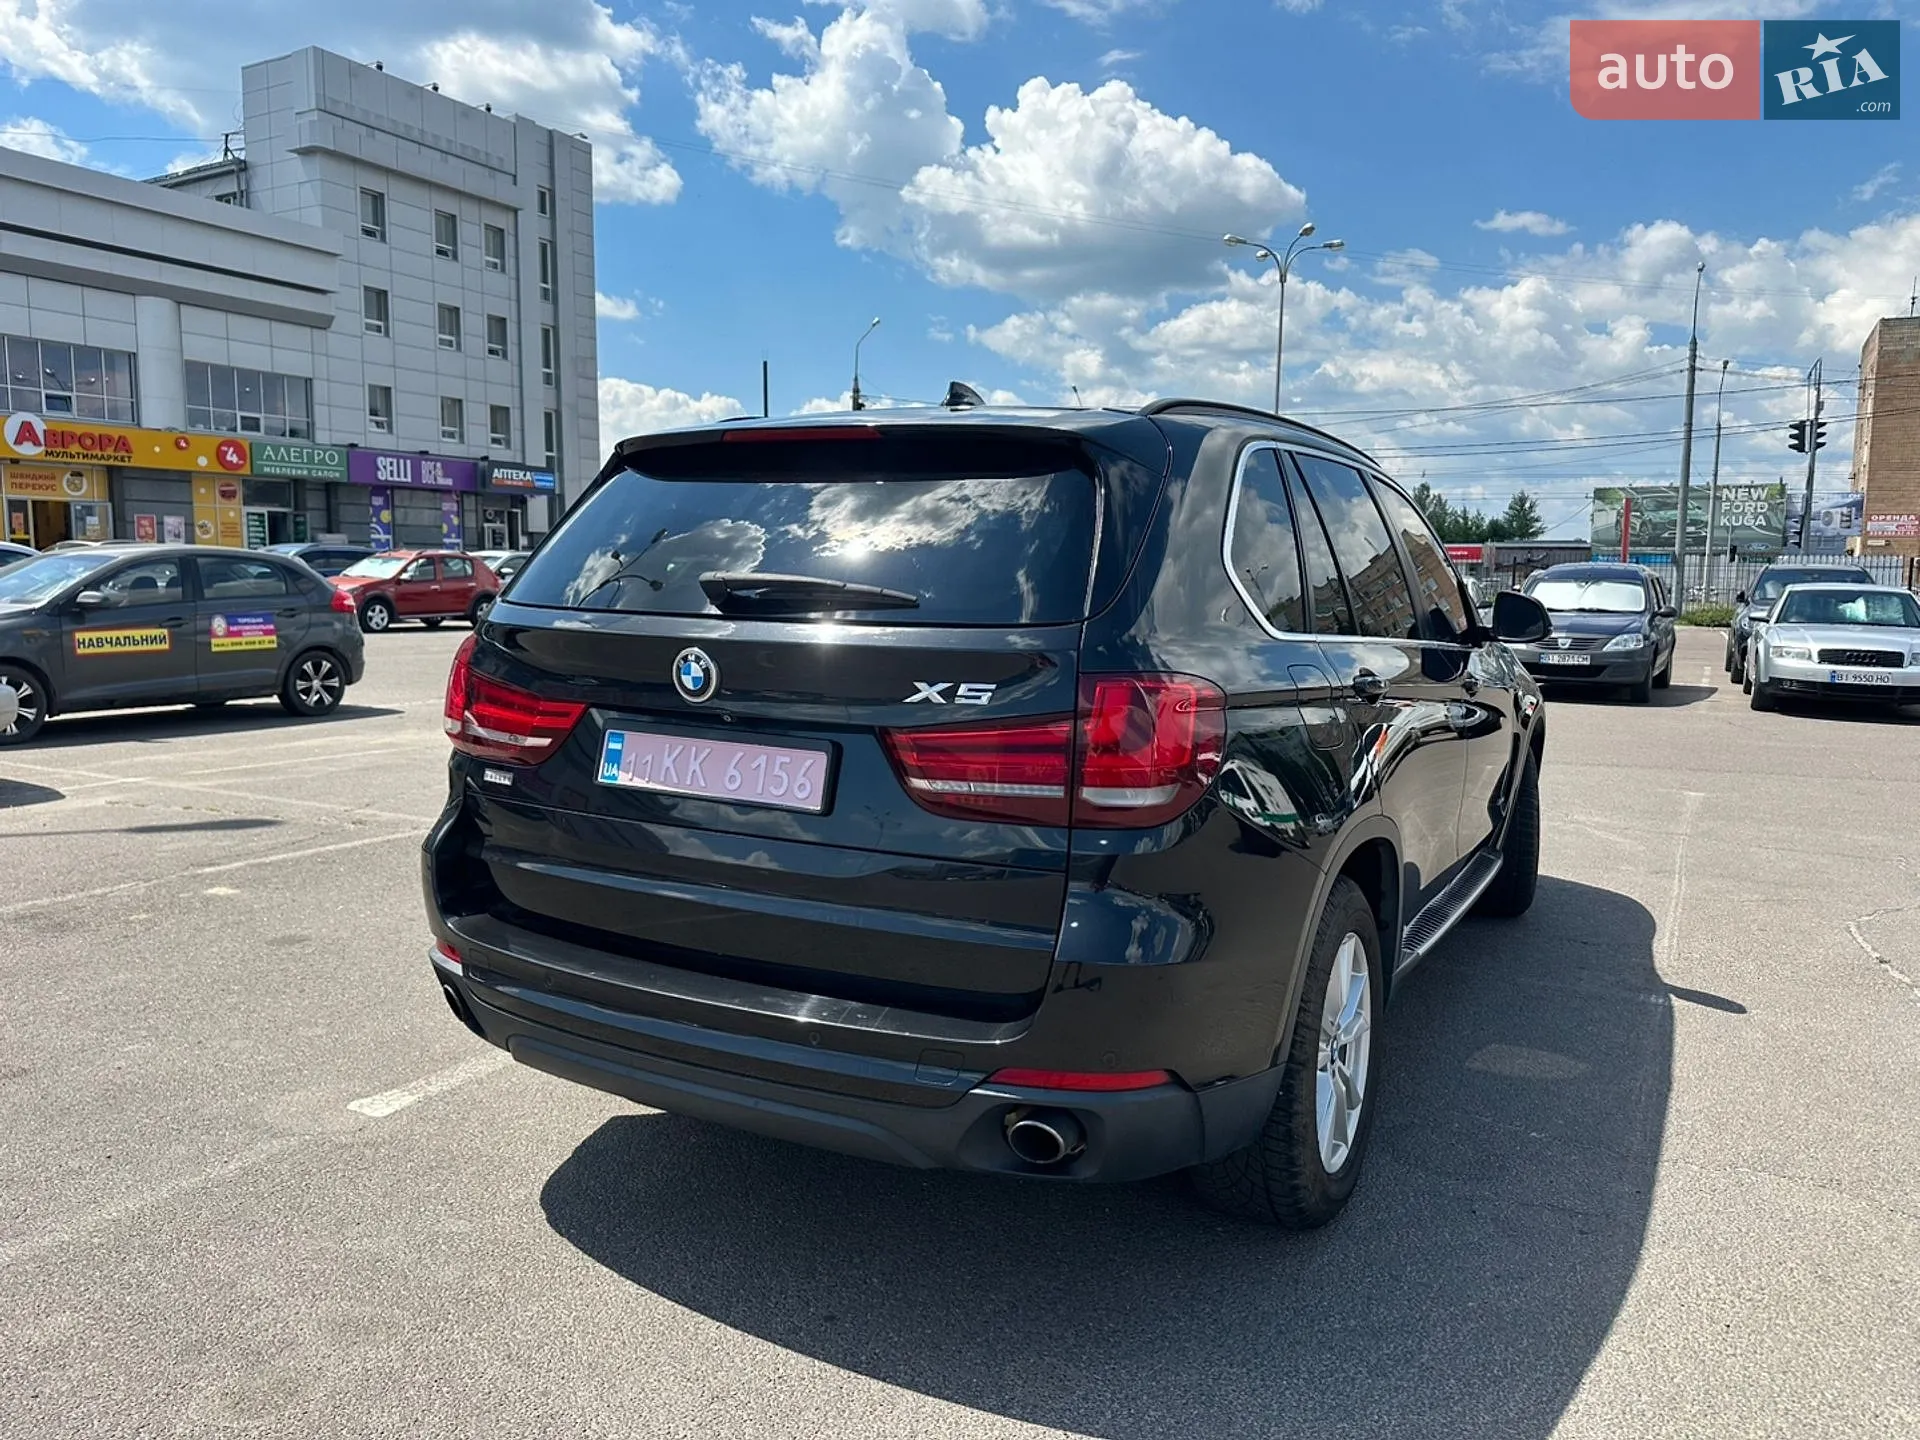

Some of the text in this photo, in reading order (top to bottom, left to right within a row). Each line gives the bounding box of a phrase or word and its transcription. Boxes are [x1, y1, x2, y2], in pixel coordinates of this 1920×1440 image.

[13, 420, 134, 454] АВРОРА
[44, 449, 133, 464] МУЛЬТИМАРКЕТ
[263, 445, 339, 465] АЛЕГРО
[311, 469, 340, 478] САЛОН
[376, 456, 412, 483] SELLI
[492, 467, 532, 481] АПТЕКА
[10, 481, 57, 492] ПЕРЕКУС
[1722, 487, 1769, 501] NEW
[1721, 501, 1768, 513] FORD
[1720, 514, 1767, 526] KUGA
[1870, 514, 1916, 522] ОРЕНДА
[77, 632, 168, 649] НАВЧАЛЬНИЙ
[902, 681, 997, 705] X5
[603, 762, 618, 777] UA
[723, 752, 817, 800] 6156
